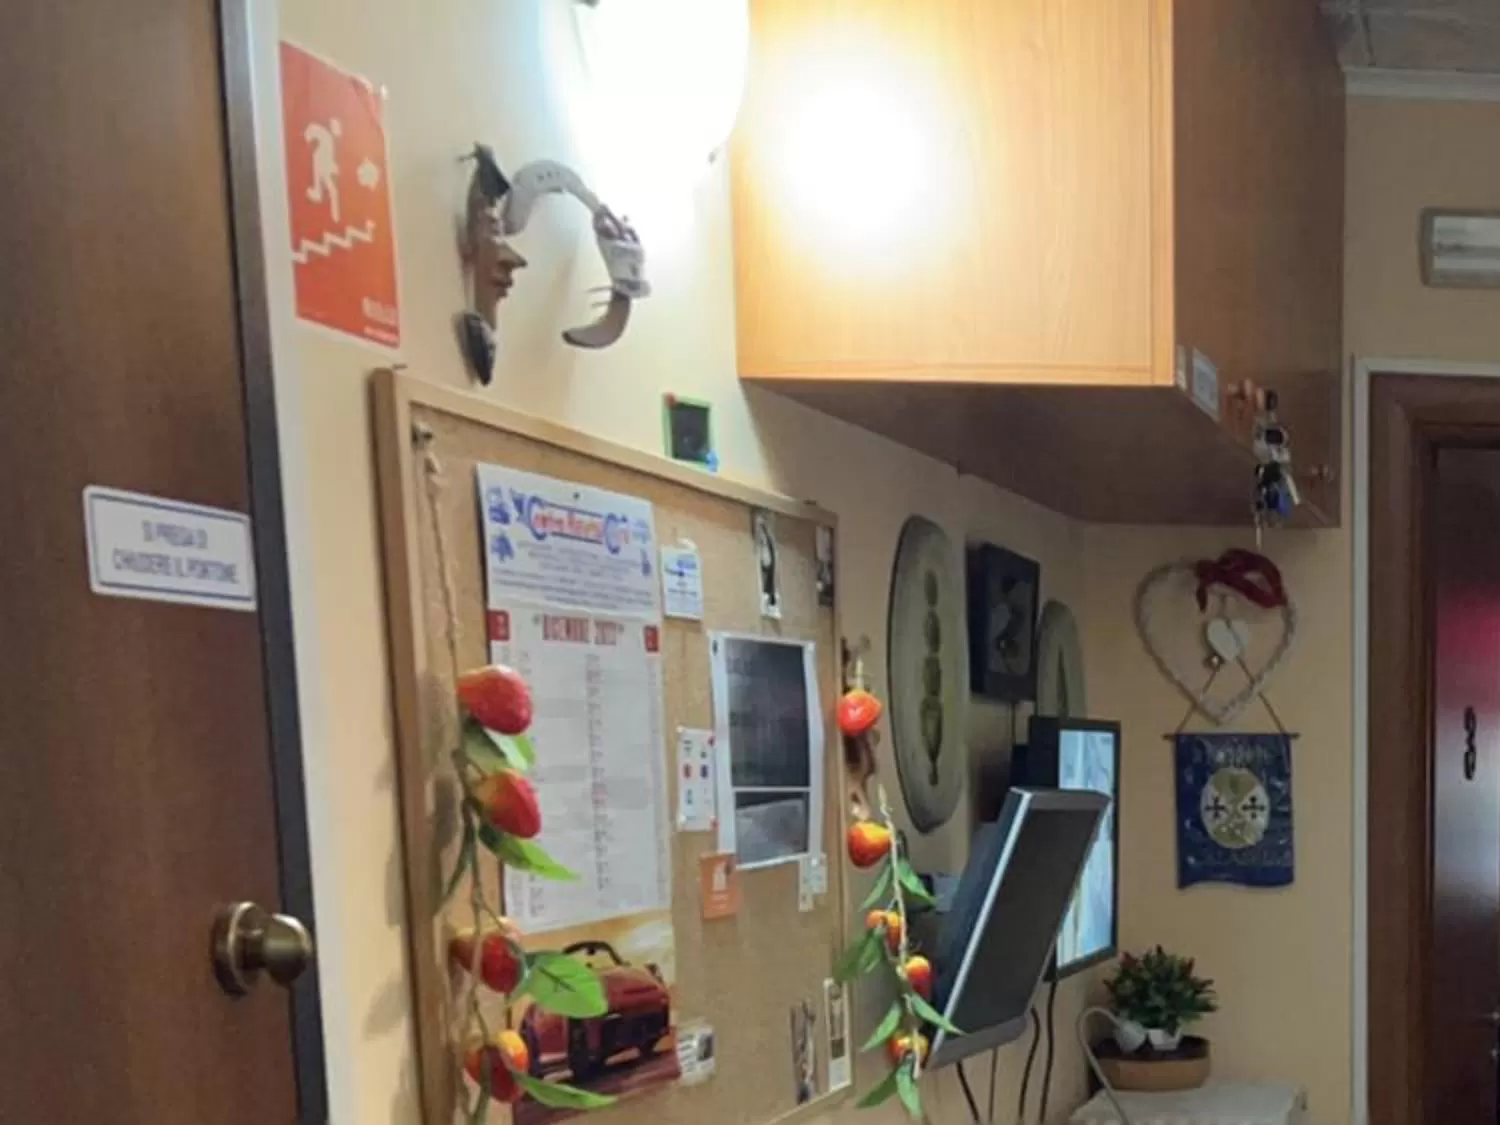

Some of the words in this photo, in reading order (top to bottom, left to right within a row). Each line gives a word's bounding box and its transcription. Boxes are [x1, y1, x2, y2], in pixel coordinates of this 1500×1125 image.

[155, 523, 194, 546] PREGA
[113, 548, 171, 575] CHIUDERE
[187, 559, 239, 583] PORTONE
